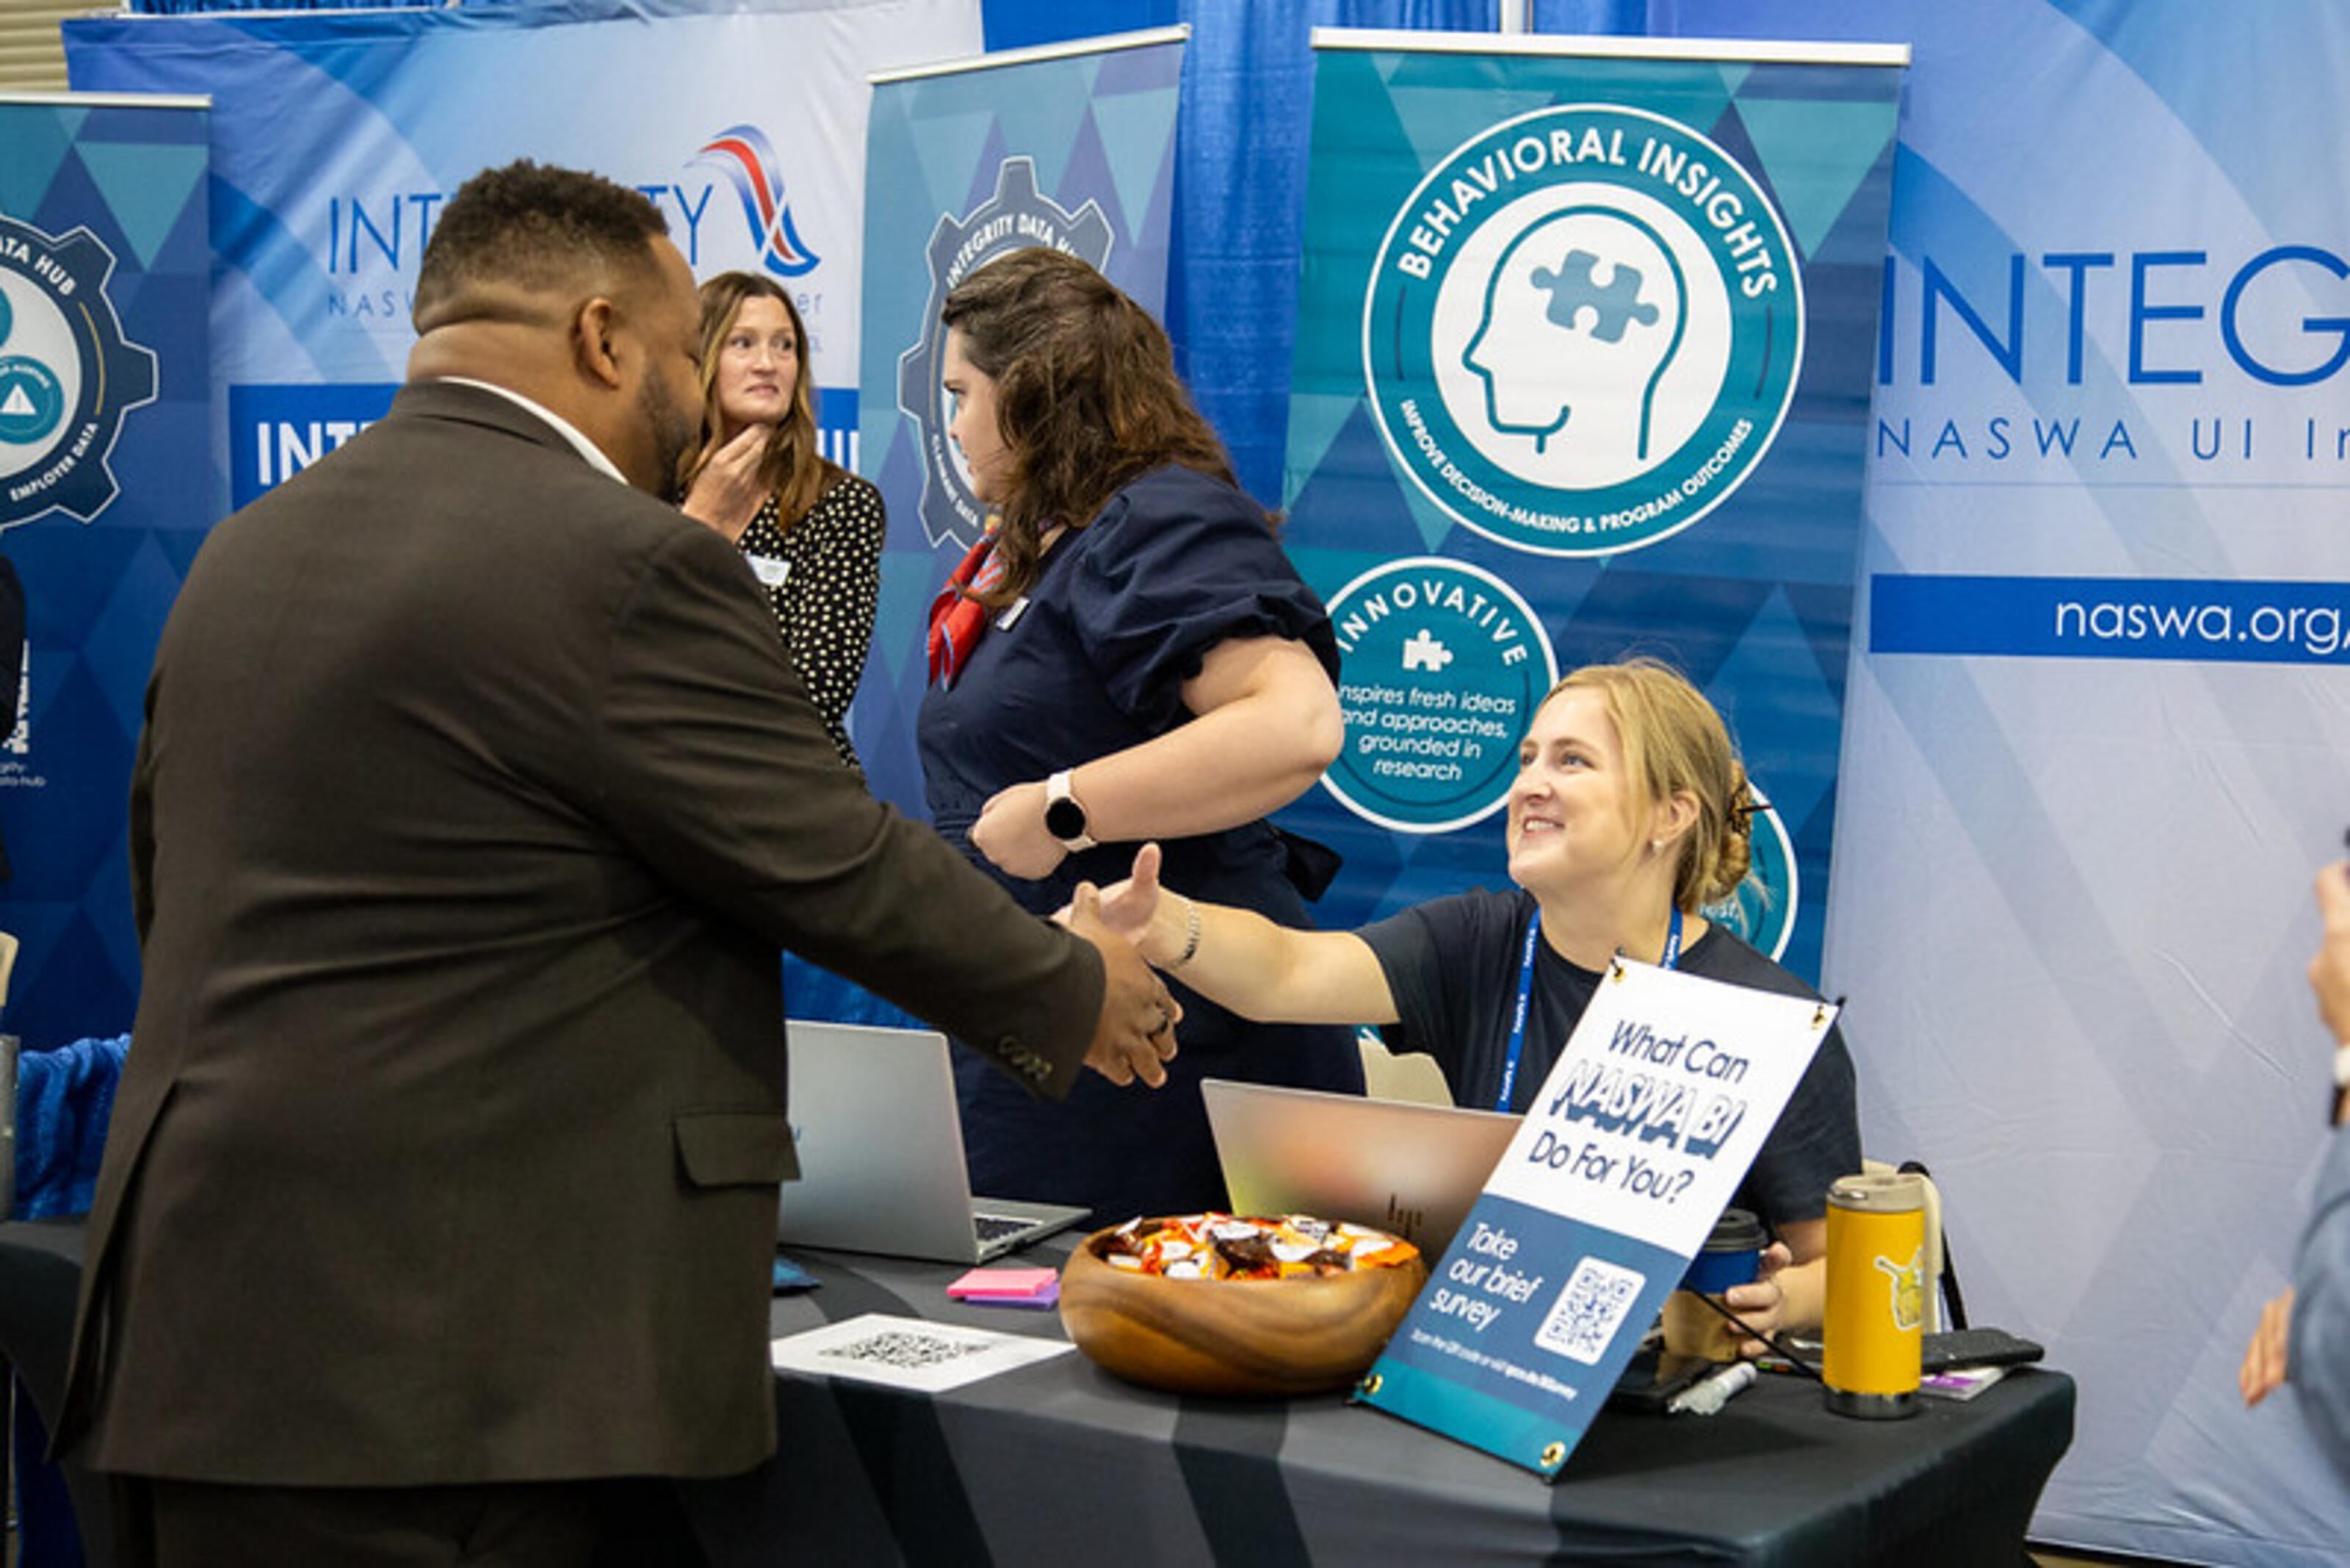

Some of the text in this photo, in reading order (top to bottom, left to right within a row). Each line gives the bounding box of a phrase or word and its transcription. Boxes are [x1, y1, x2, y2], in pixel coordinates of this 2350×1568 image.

[1017, 213, 1054, 248] DATA
[1398, 129, 1776, 297] BEHAVIORAL INSIGHTS
[34, 254, 76, 295] HUB
[1878, 245, 2350, 386] INTEG
[1878, 418, 2137, 460] NASWA
[2192, 419, 2252, 460] UI
[9, 455, 76, 502] EMPLOYER
[1400, 399, 1754, 533] IMPROVE DECISION-MAKING & PROGRAM OUTCOMES
[1336, 579, 1528, 665] INNOVATIVE
[1338, 684, 1516, 715] nspires fresh ideas
[1359, 734, 1481, 759] grounded in
[1381, 712, 1508, 739] approaches,
[1373, 759, 1463, 781] research
[1609, 1019, 1749, 1084] What Can
[1549, 1058, 1697, 1149] NASWA
[1684, 1094, 1749, 1160] BI
[1528, 1130, 1695, 1204] Do For You?
[1467, 1222, 1519, 1260] Take
[1449, 1258, 1544, 1304] our brief
[1429, 1287, 1502, 1332] survey
